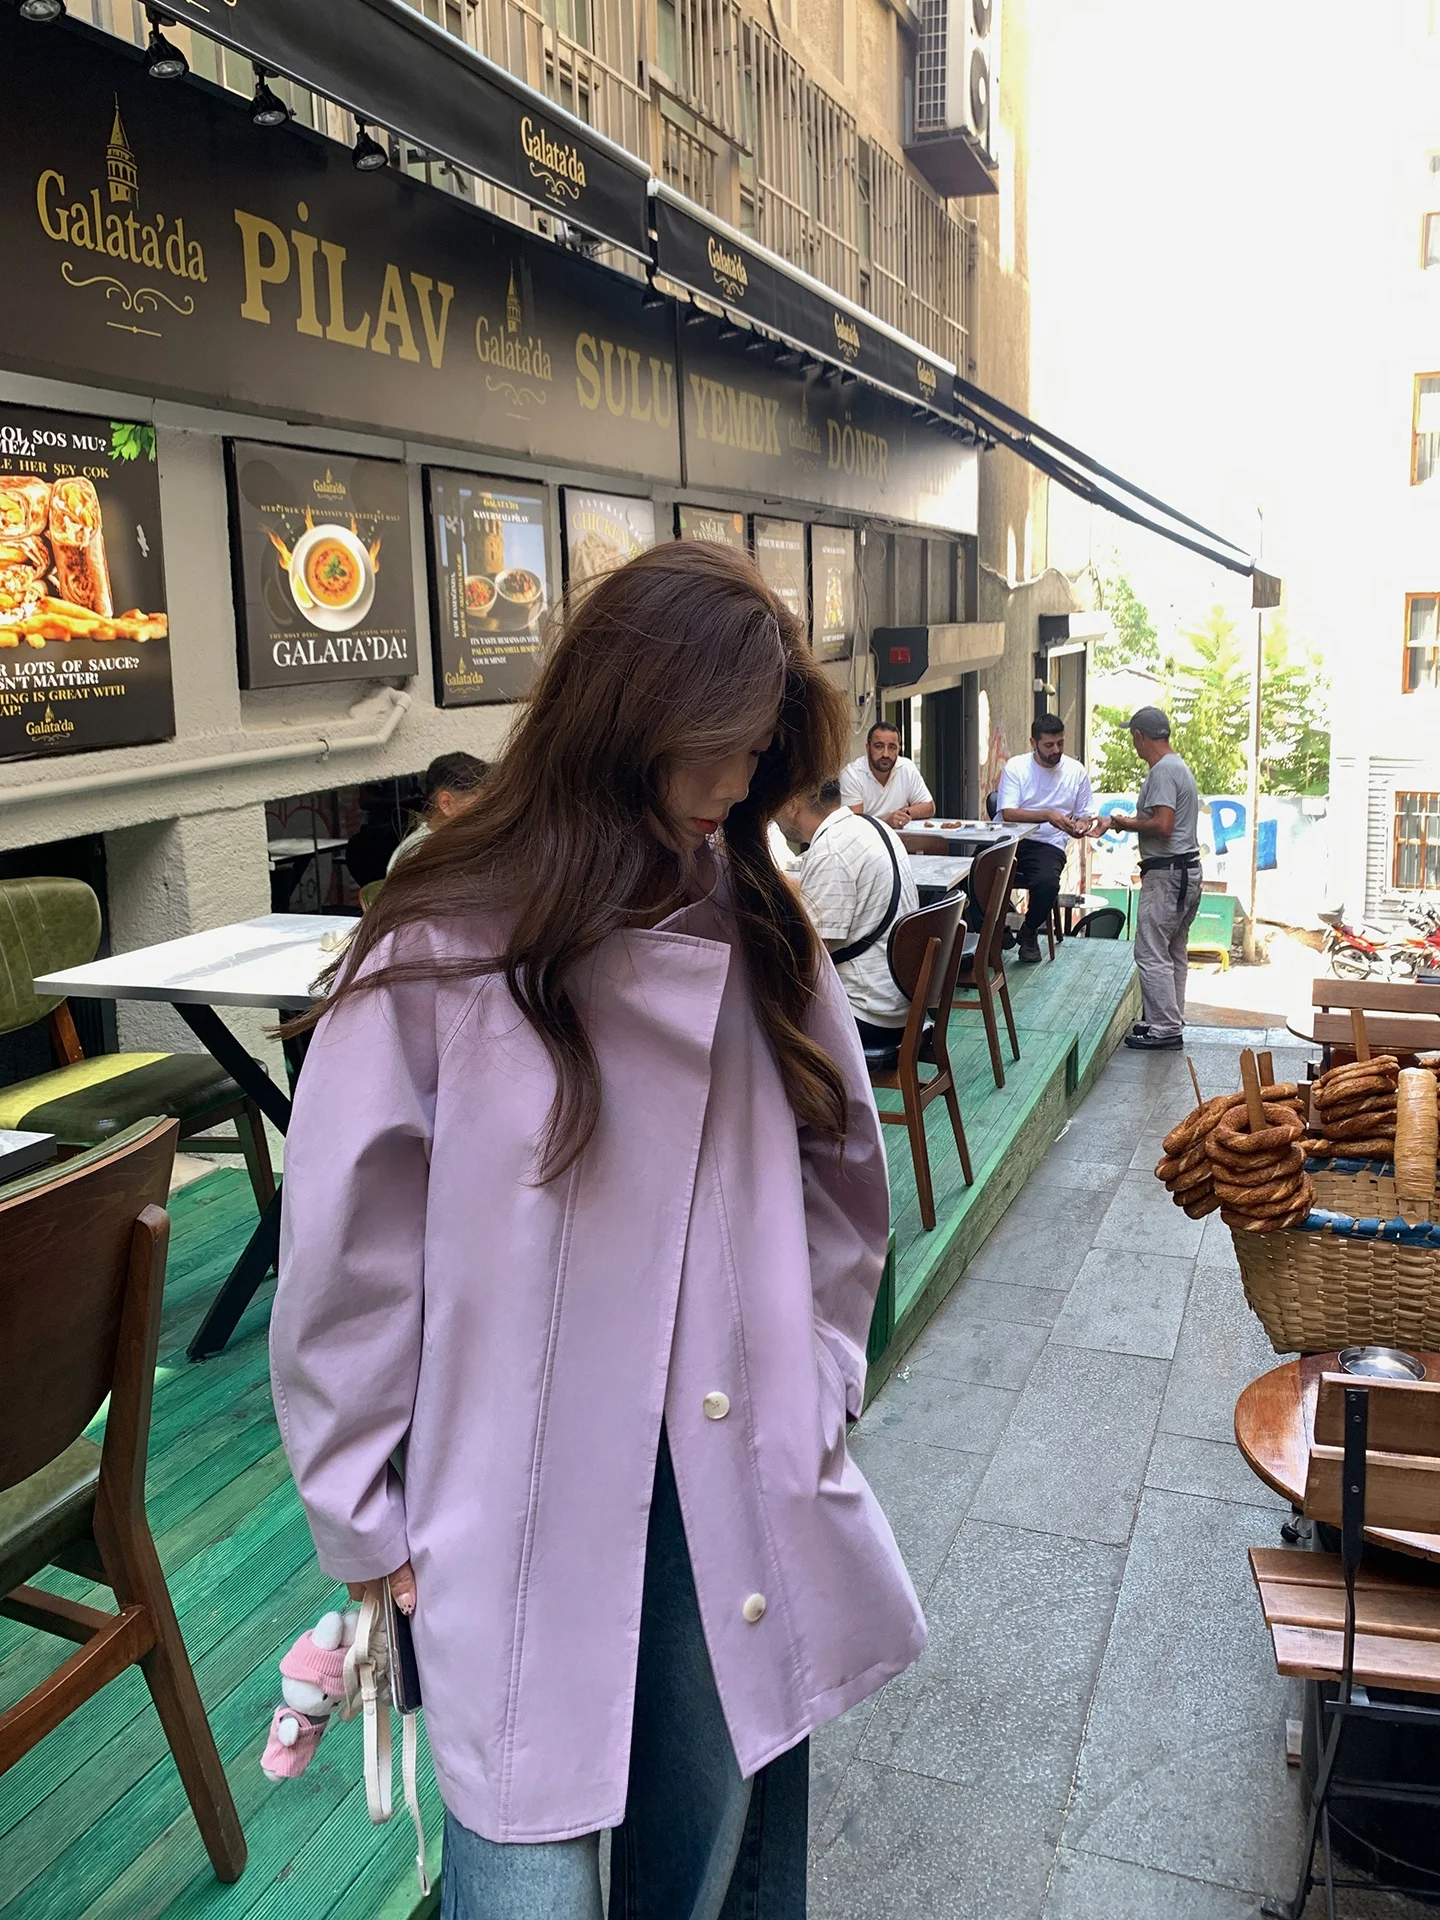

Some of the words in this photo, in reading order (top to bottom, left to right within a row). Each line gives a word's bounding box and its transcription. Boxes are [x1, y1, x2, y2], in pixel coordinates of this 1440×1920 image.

[521, 117, 586, 187] Galata'da
[36, 169, 208, 283] Galata'da
[234, 201, 455, 369] PİLAV
[475, 315, 552, 381] Galata'da
[575, 332, 673, 428] SULU
[689, 373, 781, 455] YEMEK
[0, 426, 28, 444] OL
[32, 429, 67, 448] SOS
[71, 434, 107, 452] MU?
[827, 410, 889, 483] DÖNER
[19, 459, 47, 473] HER
[53, 463, 76, 476] ŞEY
[14, 661, 55, 676] LOTS
[62, 659, 82, 673] OF
[89, 656, 140, 672] SAUCE?
[272, 636, 408, 668] GALATA'DA!
[33, 672, 99, 688] MATTER!
[33, 691, 45, 703] IS
[49, 687, 91, 701] GREAT
[93, 684, 125, 697] WITH
[445, 671, 484, 686] Galata'da
[26, 720, 75, 736] Galata'da
